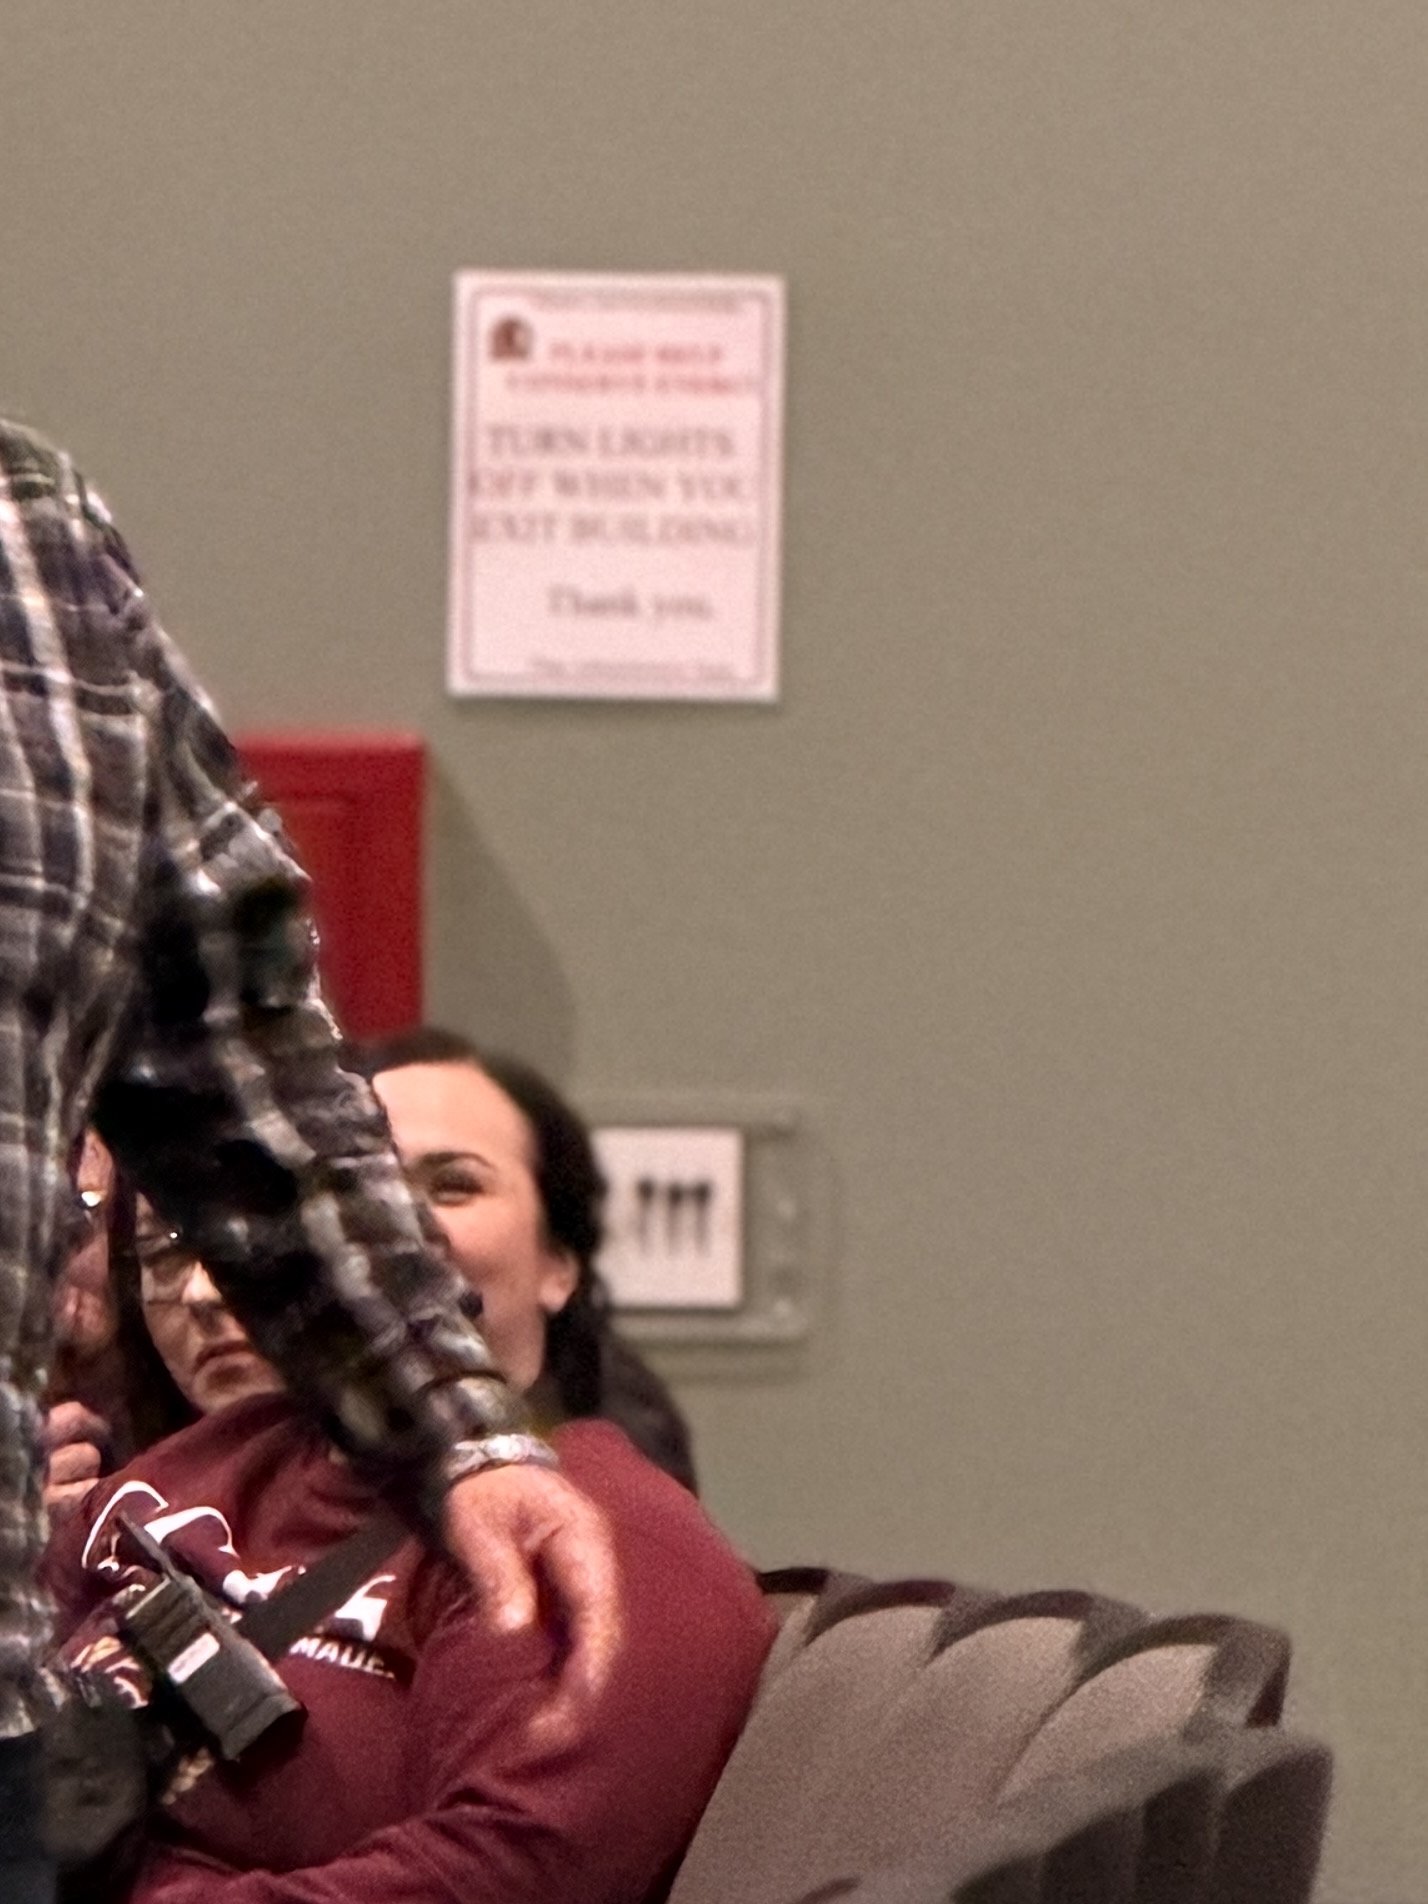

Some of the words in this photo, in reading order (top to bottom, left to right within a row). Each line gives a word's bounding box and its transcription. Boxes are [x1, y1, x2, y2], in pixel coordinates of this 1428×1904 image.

[488, 425, 588, 456] TURN
[597, 426, 735, 457] LIGHTS
[467, 468, 538, 500] OFF
[552, 469, 664, 501] WHEN
[677, 471, 746, 503] YOU
[470, 512, 558, 544] EXIT
[548, 583, 637, 618] Thank
